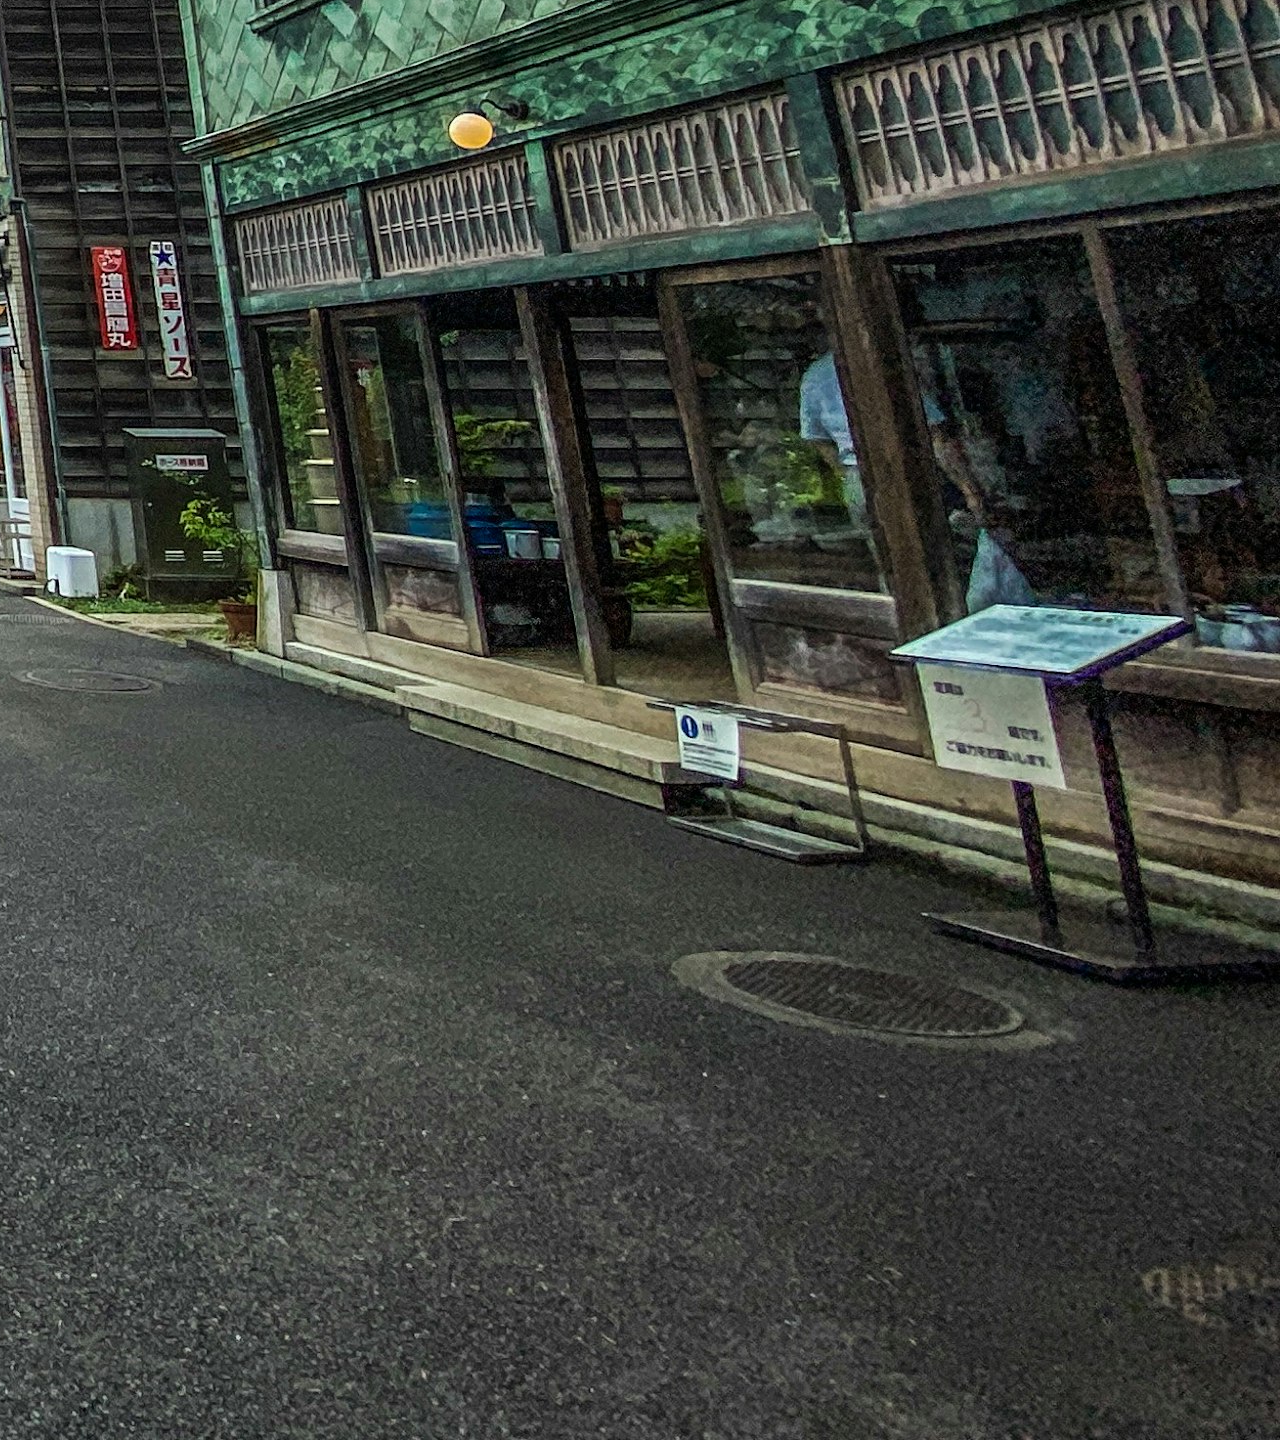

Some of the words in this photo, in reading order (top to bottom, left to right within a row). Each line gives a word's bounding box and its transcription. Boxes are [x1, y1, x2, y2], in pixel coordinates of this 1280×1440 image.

[156, 268, 190, 376] 青星ソース
